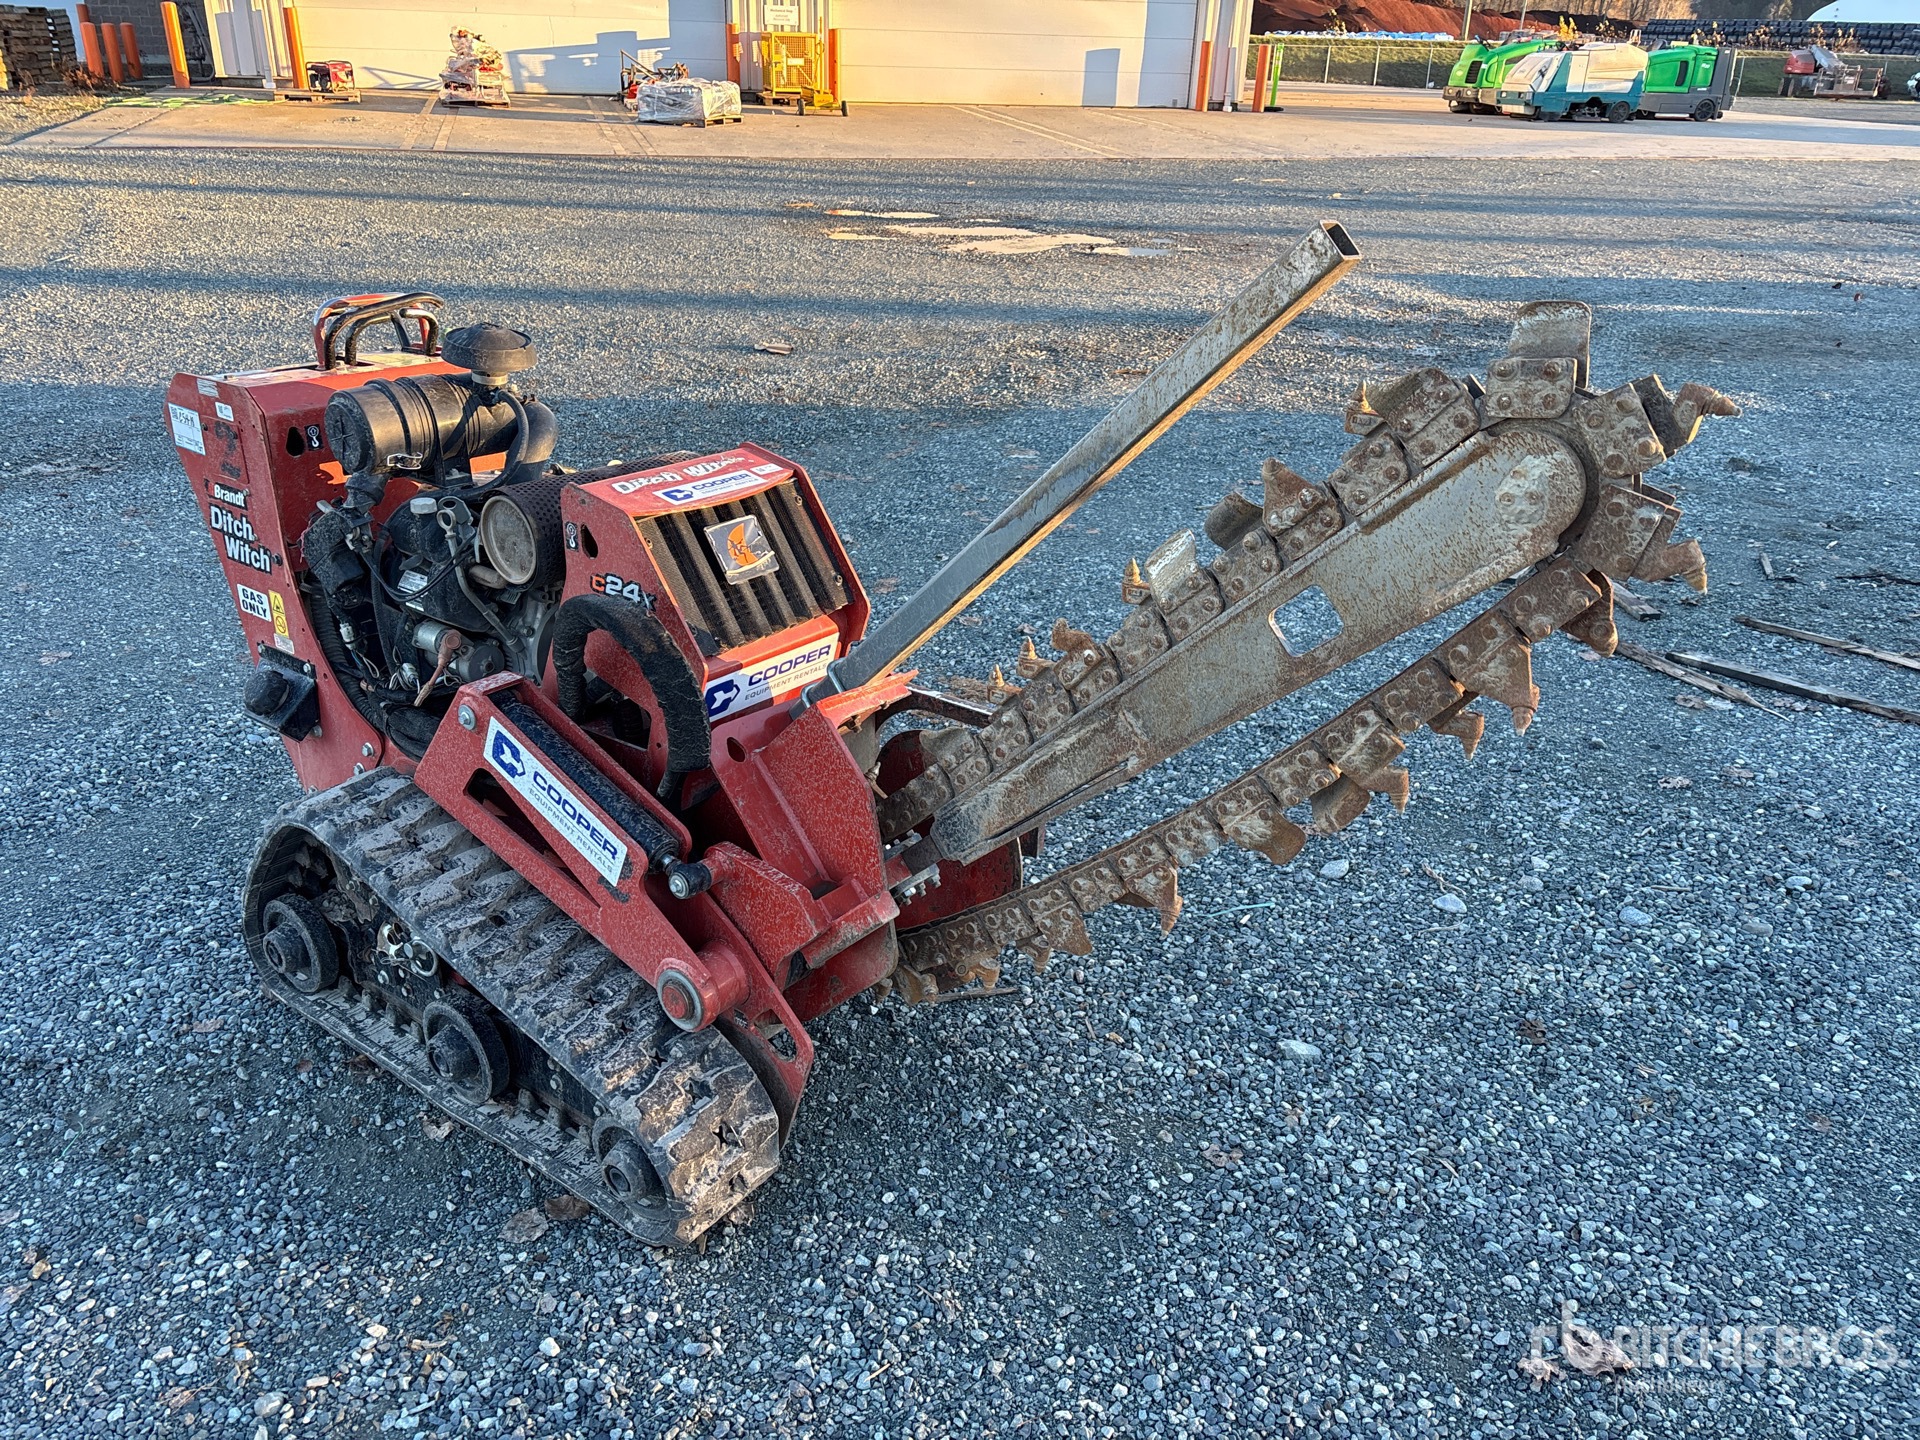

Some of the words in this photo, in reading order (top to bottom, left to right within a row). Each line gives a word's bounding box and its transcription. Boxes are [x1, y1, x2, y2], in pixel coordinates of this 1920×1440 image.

[213, 483, 245, 507] Brandt
[692, 473, 751, 490] COOPER
[210, 505, 253, 541] Ditch
[224, 535, 271, 573] Witch
[241, 588, 264, 606] GAS
[241, 599, 267, 618] ONLY
[744, 675, 792, 701] EQUIPMENT
[793, 662, 828, 682] RENTALS
[748, 644, 832, 687] COOPER
[528, 785, 577, 836] EQUIPMENT
[576, 834, 614, 874] RENTALS
[532, 770, 619, 861] COOPER
